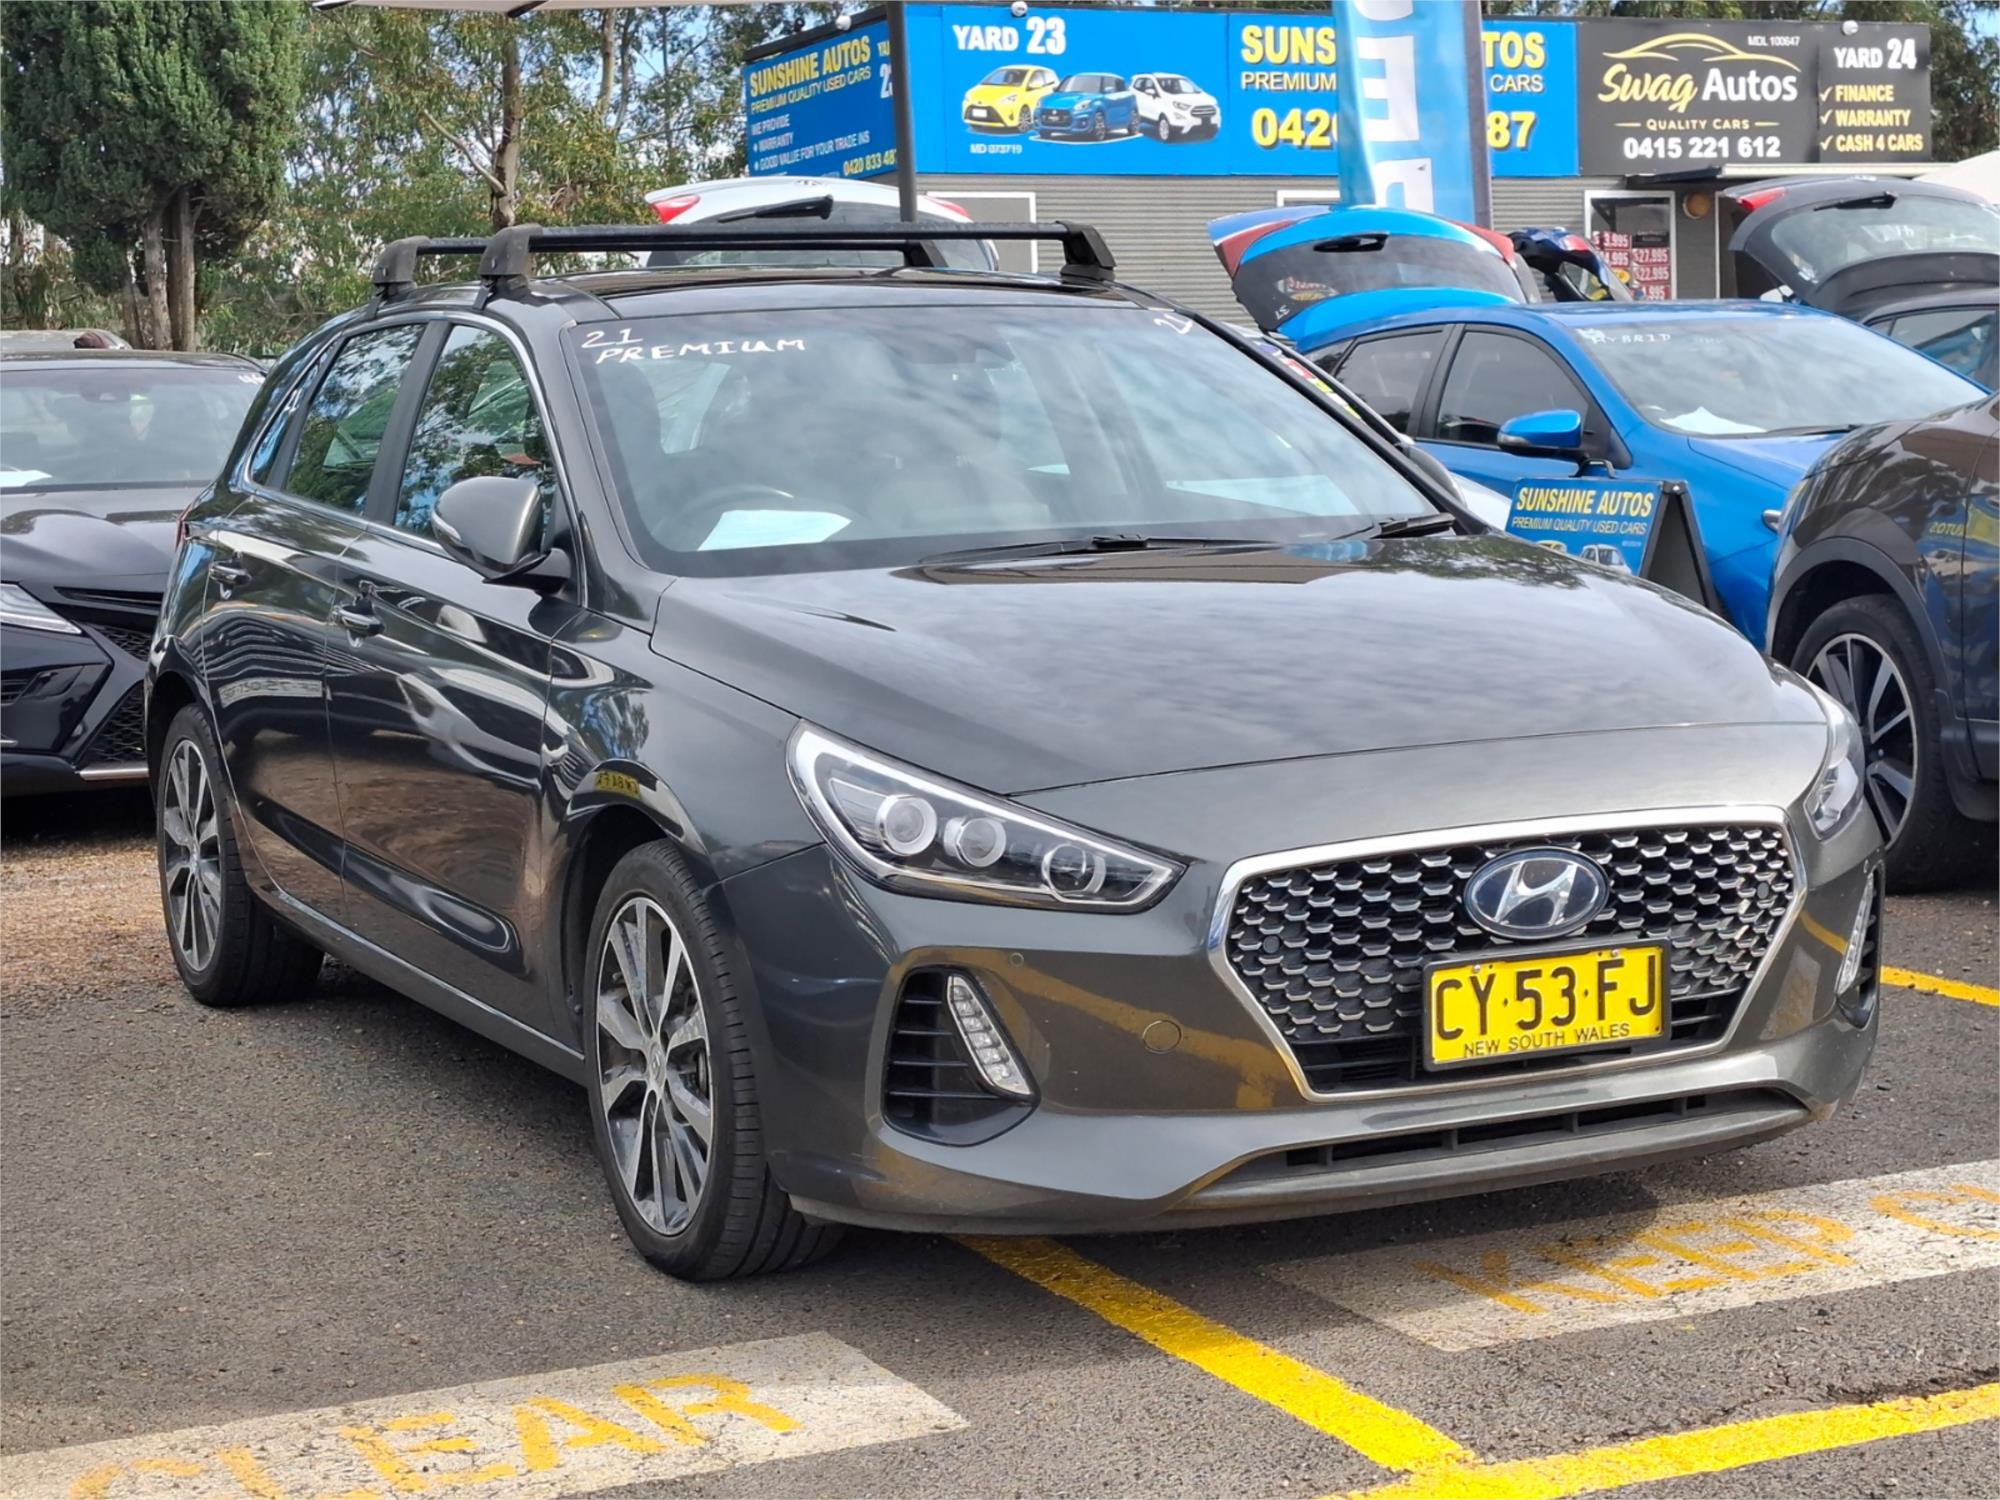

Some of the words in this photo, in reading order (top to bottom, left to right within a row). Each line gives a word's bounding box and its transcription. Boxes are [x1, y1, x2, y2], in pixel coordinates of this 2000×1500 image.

[952, 24, 1019, 51] YARD
[1026, 16, 1067, 55] 23
[1241, 24, 1337, 65] SUNS
[1480, 31, 1546, 69] TOS
[1748, 36, 1768, 46] MDL
[1833, 47, 1883, 69] YARD
[1886, 37, 1917, 69] 24
[750, 52, 820, 97] SUNSHINE
[823, 35, 871, 75] AUTOS
[751, 93, 787, 114] PREMIUM
[788, 82, 822, 103] QUALITY
[823, 74, 846, 92] USED
[848, 66, 871, 84] CARS
[880, 64, 894, 98] 2
[1241, 71, 1337, 91] PREMIUM
[1490, 73, 1544, 93] CARS
[1597, 63, 1698, 113] Swag
[1702, 67, 1798, 102] Autos
[1835, 85, 1895, 102] FINANCE
[1252, 107, 1338, 147] 042
[1486, 110, 1537, 149] 87
[1646, 119, 1708, 131] QUALITY
[1712, 118, 1750, 131] CARS
[1835, 109, 1911, 126] WARRANTY
[1623, 136, 1682, 159] 0415
[1688, 136, 1729, 158] 221
[1737, 136, 1781, 158] 612
[1836, 134, 1874, 152] CASH
[1876, 134, 1885, 151] 4
[1887, 134, 1923, 152] CARS
[843, 158, 864, 176] 0420
[865, 152, 882, 170] 833
[582, 328, 643, 348] 21
[596, 339, 805, 364] PREMIUM
[1517, 487, 1596, 514] SUNSHINE
[1597, 491, 1654, 517] AUTOS
[1512, 516, 1552, 530] PREMIUM
[1553, 519, 1591, 532] QUALITY
[1593, 521, 1618, 534] USED
[1620, 521, 1647, 535] CARS
[1464, 1038, 1500, 1058] NEW
[1508, 1031, 1565, 1052] SOUTH
[1576, 1023, 1630, 1043] WALES
